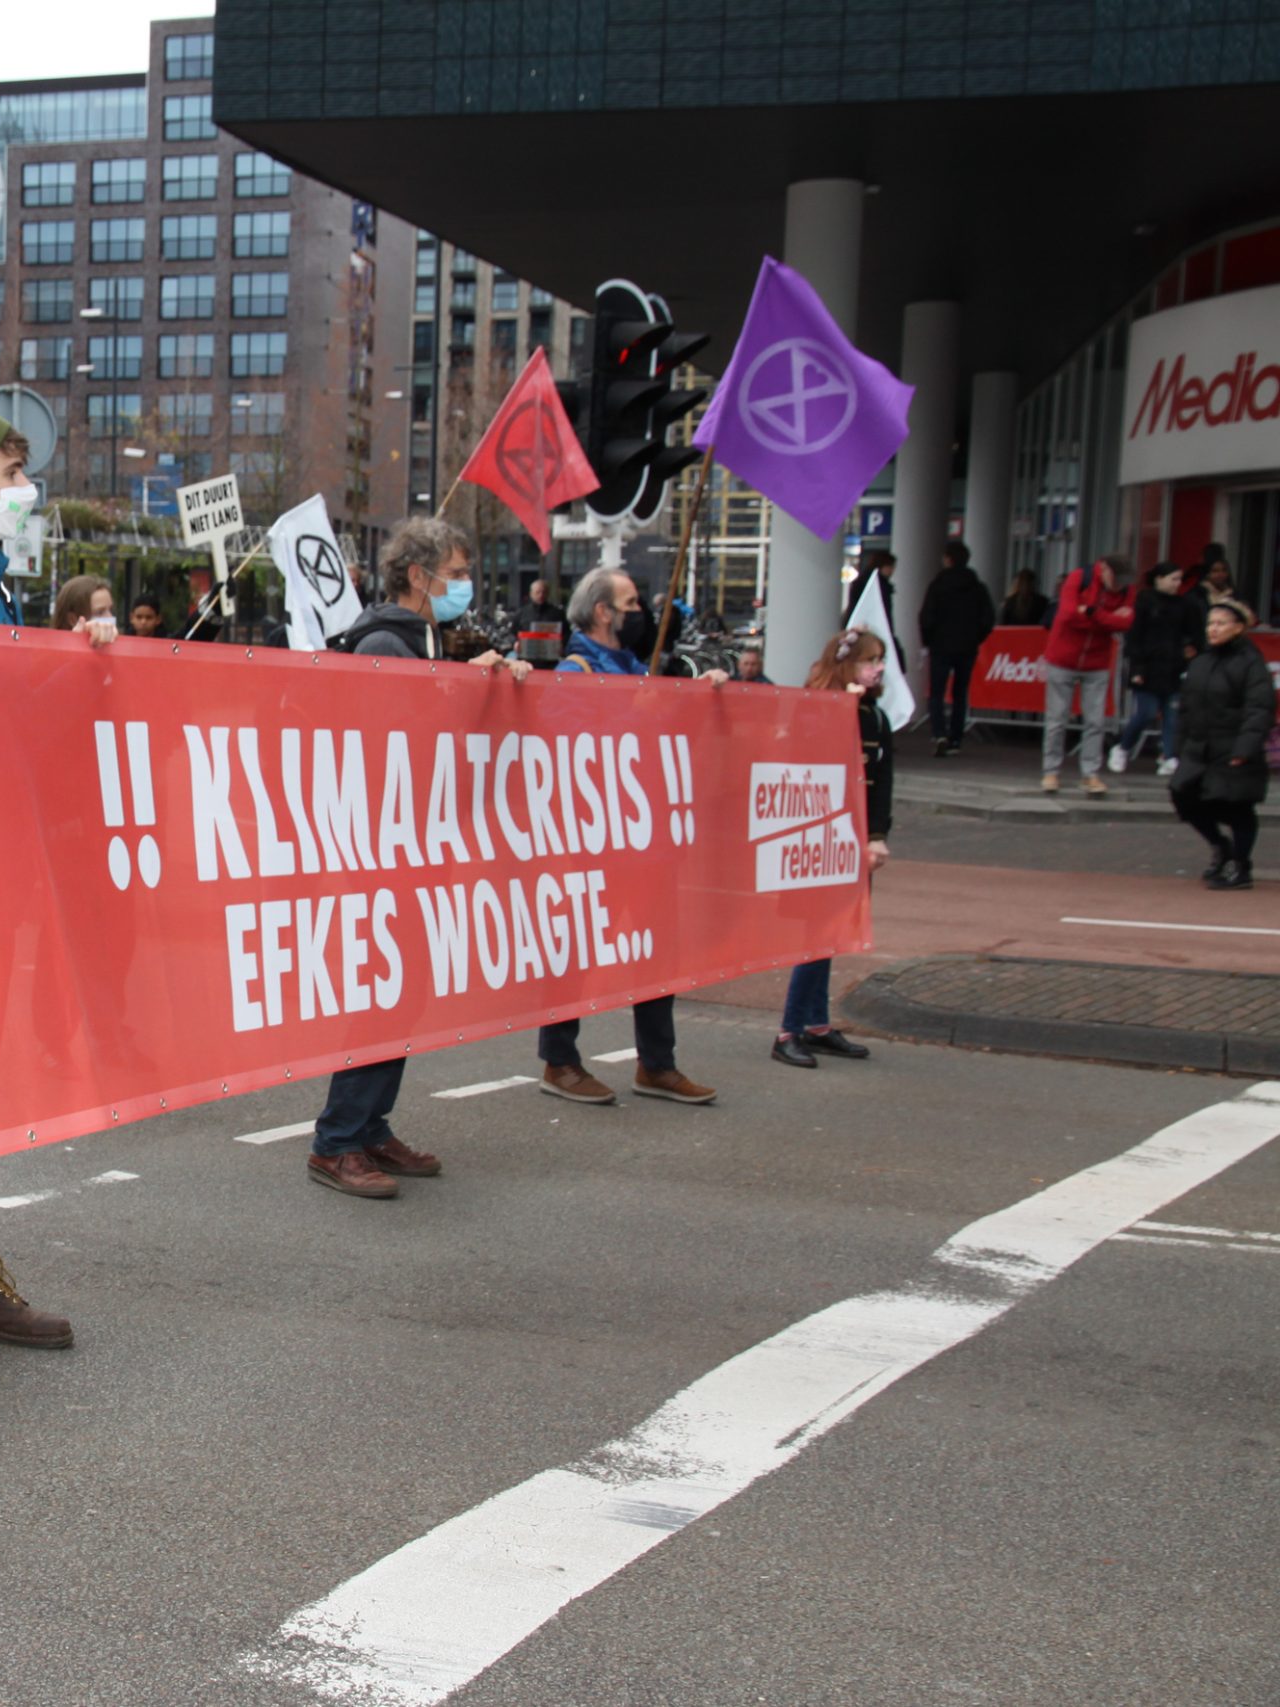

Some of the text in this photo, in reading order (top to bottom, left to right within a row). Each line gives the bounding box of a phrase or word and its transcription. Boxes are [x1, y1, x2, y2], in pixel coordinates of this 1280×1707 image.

[1128, 350, 1280, 441] Media
[185, 481, 234, 511] DIT DUURT
[189, 505, 238, 536] NIET LANG
[867, 511, 883, 534] P
[183, 724, 652, 882] KLIMAATCRISIS
[755, 769, 833, 820] extinction
[781, 821, 856, 881] rebellion
[225, 870, 653, 1033] EFKES WOAGTE...
